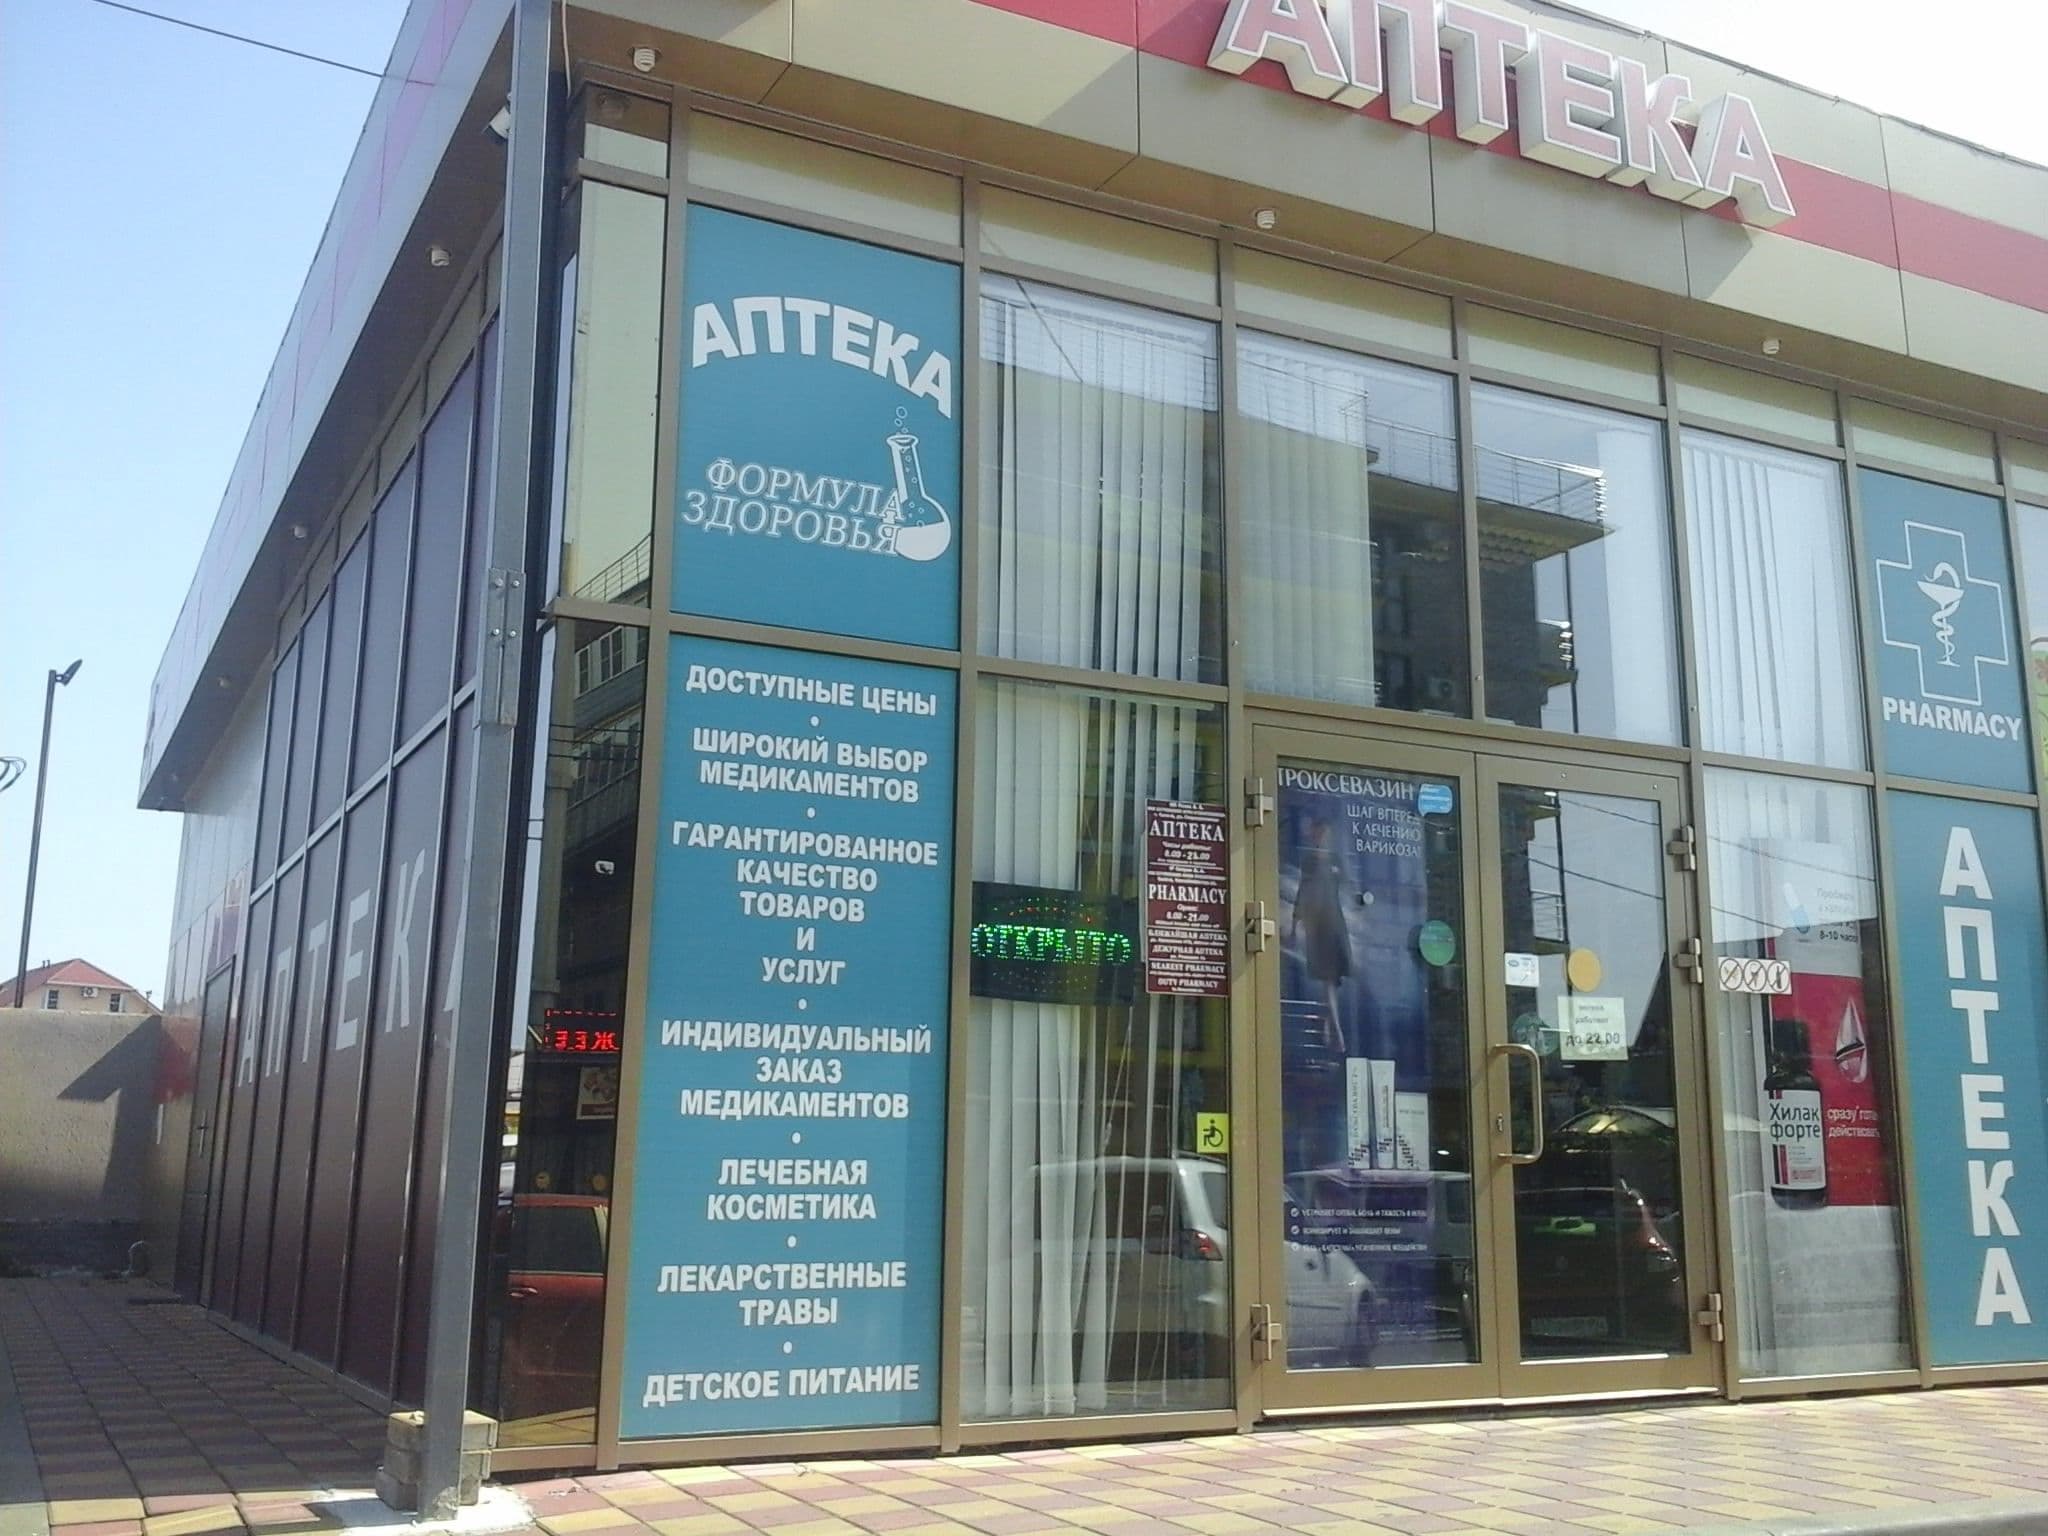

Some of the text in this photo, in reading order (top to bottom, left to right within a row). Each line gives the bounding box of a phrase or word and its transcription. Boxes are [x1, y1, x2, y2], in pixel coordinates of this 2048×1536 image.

[1208, 0, 1797, 224] АПТЕКА
[692, 296, 952, 419] АПТЕКА
[705, 456, 907, 523] ФОРМУЛА
[682, 490, 902, 557] ЗДОРОВЬЯ
[686, 664, 937, 716] ДОСТУПНЫЕ ЦЕНЫ
[1882, 696, 2024, 742] PHARMACY
[693, 727, 928, 774] ШИРОКИЙ ВЫБОР
[700, 759, 919, 803] МЕДИКАМЕНТОВ
[1347, 804, 1375, 818] ШАГ
[672, 821, 939, 866] ГАРАНТИРОВАННОЕ
[1149, 819, 1225, 842] АПТЕКА
[1352, 821, 1422, 842] К ЛЕЧЕНИЮ
[737, 858, 878, 892] КАЧЕСТВО
[740, 890, 865, 923] ТОВАРОВ
[1149, 884, 1227, 905] PHARMACY
[796, 926, 815, 952] И
[971, 923, 1131, 965] ОТКРЫТО
[1195, 947, 1224, 956] АПТЕКА
[761, 957, 846, 985] УСЛУГ
[660, 1020, 932, 1053] ИНДИВИДУАЛЬНЫЙ
[756, 1056, 843, 1083] ЗАКАЗ
[1939, 825, 2033, 1327] АПТЕКА
[680, 1089, 909, 1119] МЕДИКАМЕНТОВ
[1770, 1102, 1820, 1121] Хилак
[1827, 1108, 1857, 1123] сразу
[1770, 1121, 1820, 1142] форте
[718, 1159, 868, 1185] ЛЕЧЕБНАЯ
[706, 1193, 877, 1220] КОСМЕТИКА
[657, 1261, 908, 1292] ЛЕКАРСТВЕННЫЕ
[739, 1297, 838, 1325] ТРАВЫ
[642, 1364, 920, 1408] ДЕТСКОЕ ПИТАНИЕ
